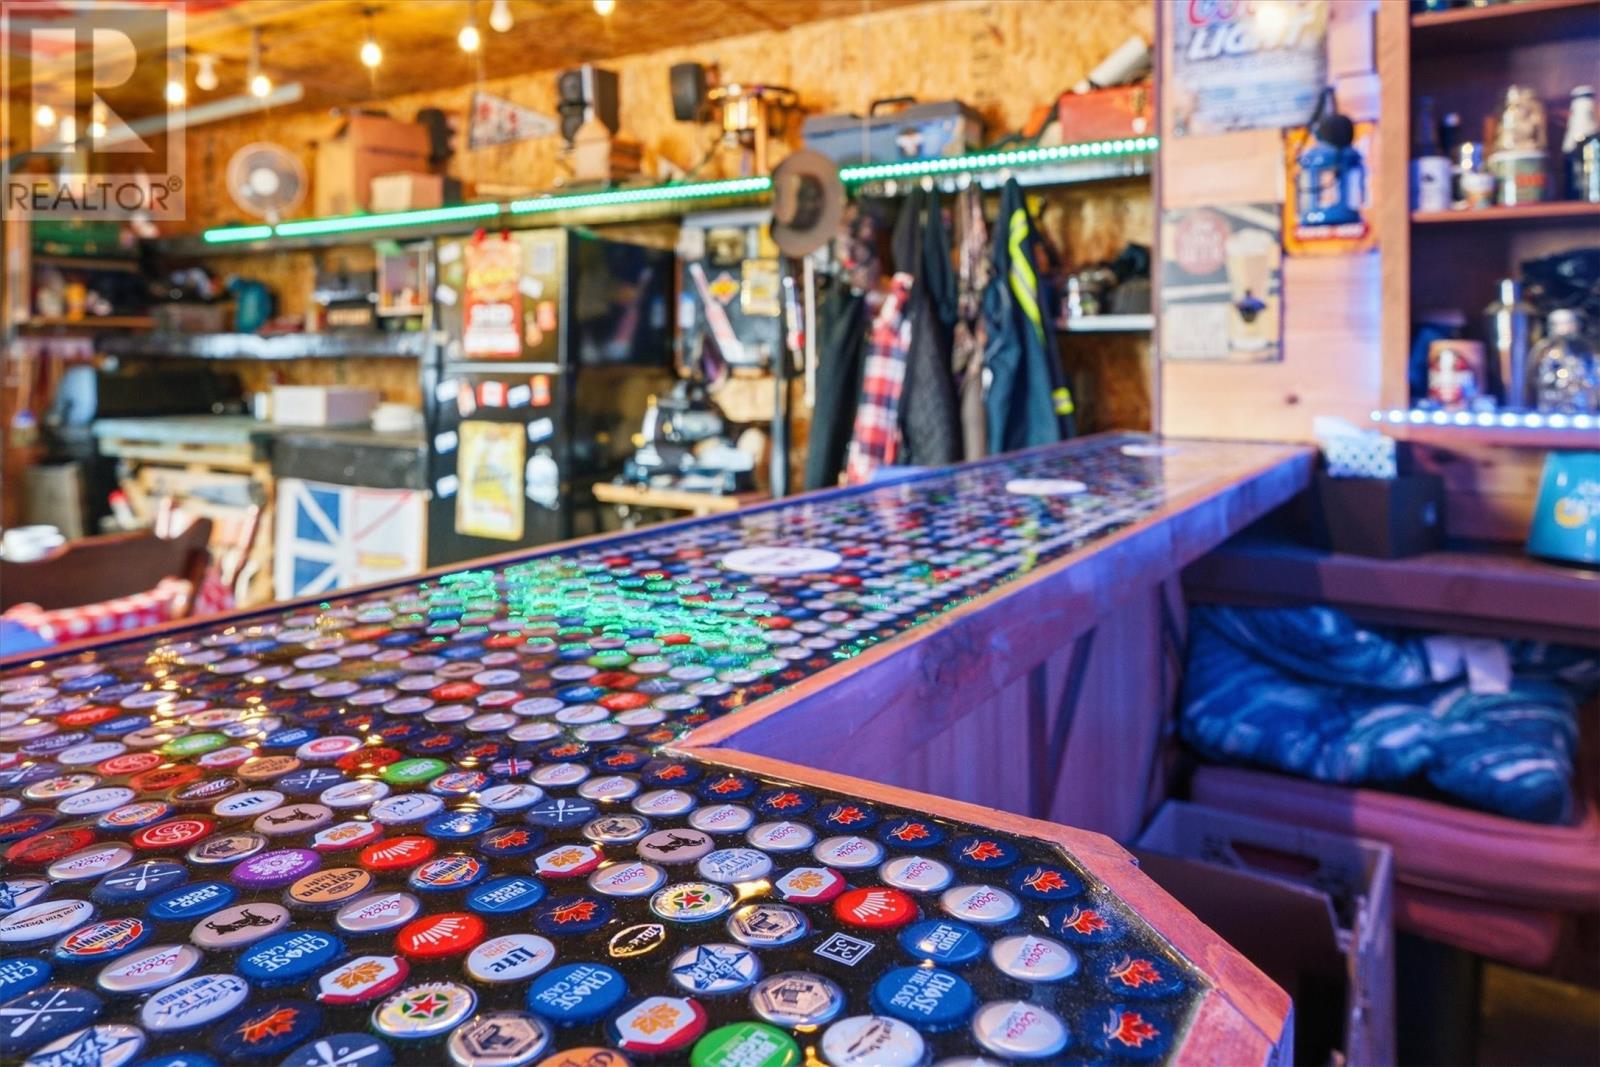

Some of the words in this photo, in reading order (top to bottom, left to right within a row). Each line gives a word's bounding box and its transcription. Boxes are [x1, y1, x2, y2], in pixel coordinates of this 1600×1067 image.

[229, 797, 264, 811] Lite
[710, 808, 736, 823] Coors
[769, 826, 797, 842] Coors
[837, 841, 865, 857] Coors
[416, 856, 472, 885] COMMUNITY
[712, 851, 761, 875] ULTRA
[906, 861, 932, 880] Coors
[300, 869, 362, 897] Corona
[612, 868, 646, 886] Coors
[168, 885, 219, 907] LIGHT
[180, 890, 219, 908] BUD
[482, 881, 525, 903] LIGHT
[495, 887, 527, 904] BUD
[968, 892, 1000, 911] Coors
[360, 900, 400, 920] Coors
[60, 917, 143, 954] COMMUNITY
[285, 933, 317, 949] THE
[916, 924, 952, 952] LIGH
[938, 932, 962, 950] BUD
[248, 945, 285, 964] CASE
[264, 936, 329, 972] CHASE
[489, 947, 537, 973] Lite
[1025, 942, 1051, 968] Coors
[126, 954, 178, 977] Coors
[565, 965, 595, 984] THE
[688, 948, 737, 983] STAR
[702, 962, 734, 990] BLUE
[909, 968, 934, 987] THE
[155, 979, 237, 1016] ULTRA
[536, 982, 570, 1003] CASE
[551, 970, 613, 1010] CHASE
[890, 983, 918, 1009] CASE
[908, 973, 956, 1016] CHASE
[1006, 1010, 1041, 1040] Coors
